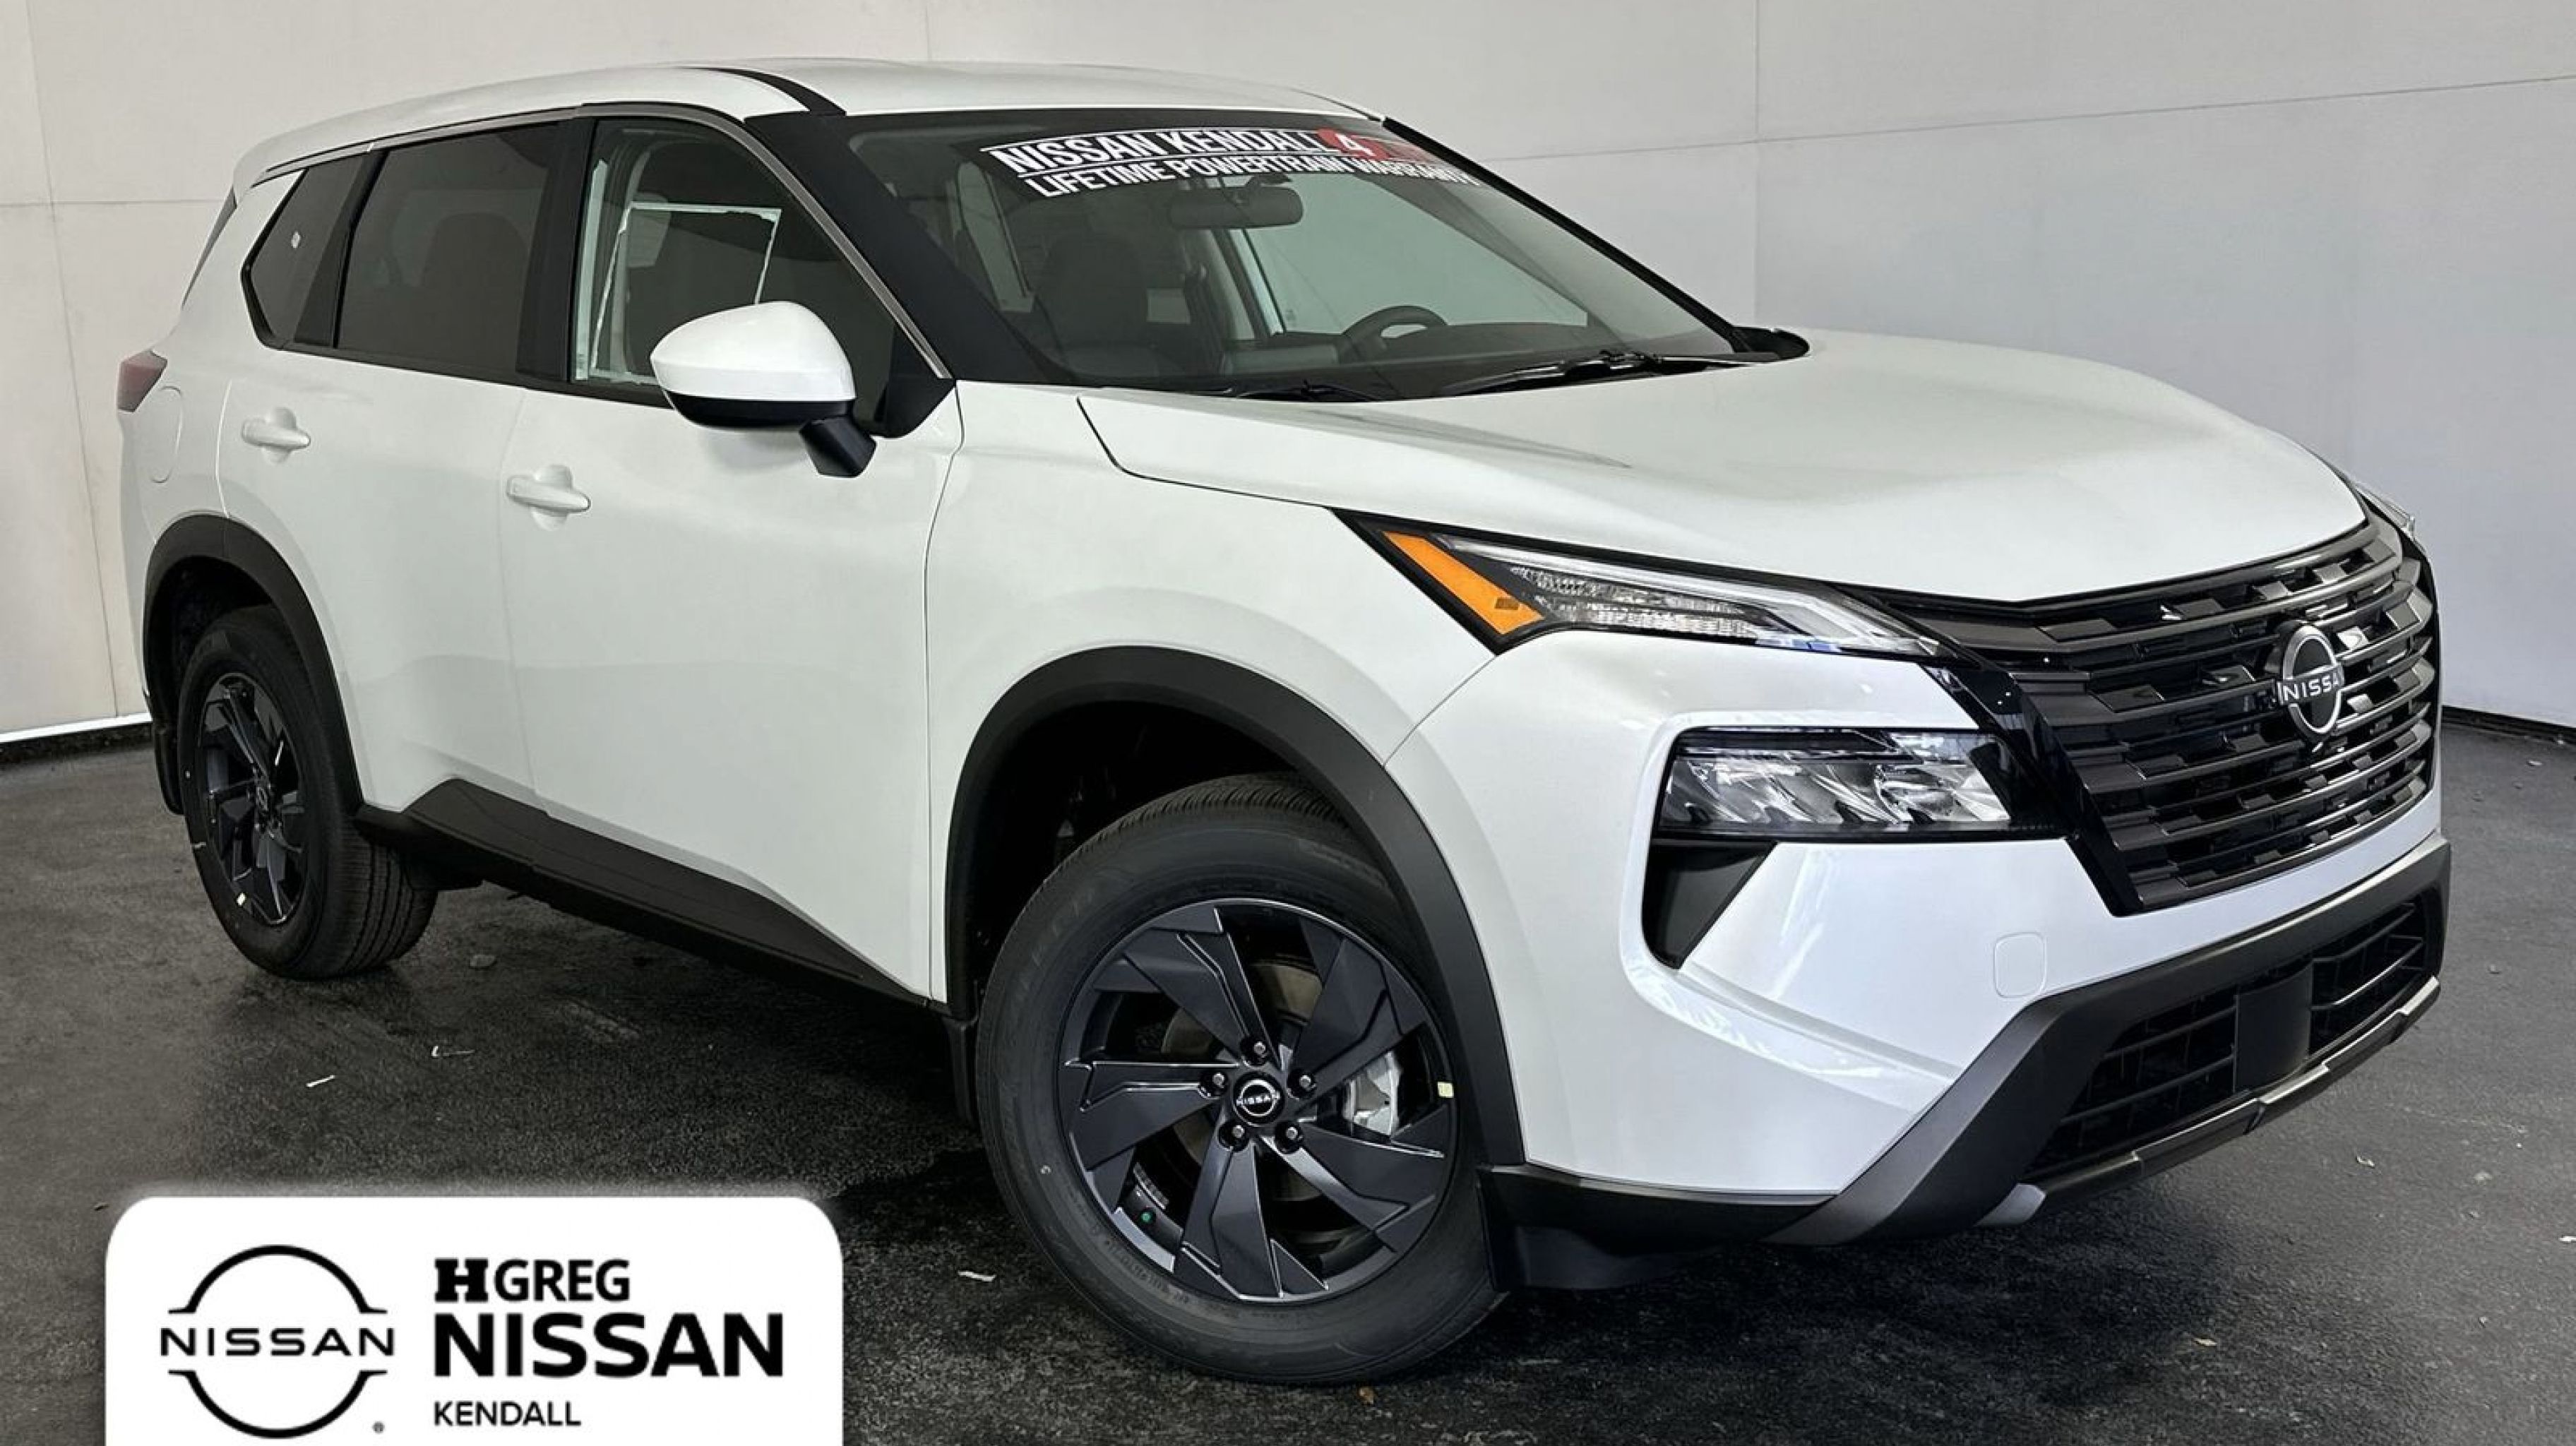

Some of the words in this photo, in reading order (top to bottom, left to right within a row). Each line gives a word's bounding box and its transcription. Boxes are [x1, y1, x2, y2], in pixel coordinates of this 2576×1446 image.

[989, 133, 1168, 174] NISSAN
[1155, 130, 1340, 154] KENDALL
[1335, 132, 1376, 157] 4
[1024, 162, 1176, 197] LIFETIME
[1163, 155, 1355, 177] POWERTRAIN
[2282, 672, 2340, 701] NISSA
[1236, 1092, 1280, 1106] NISSAN
